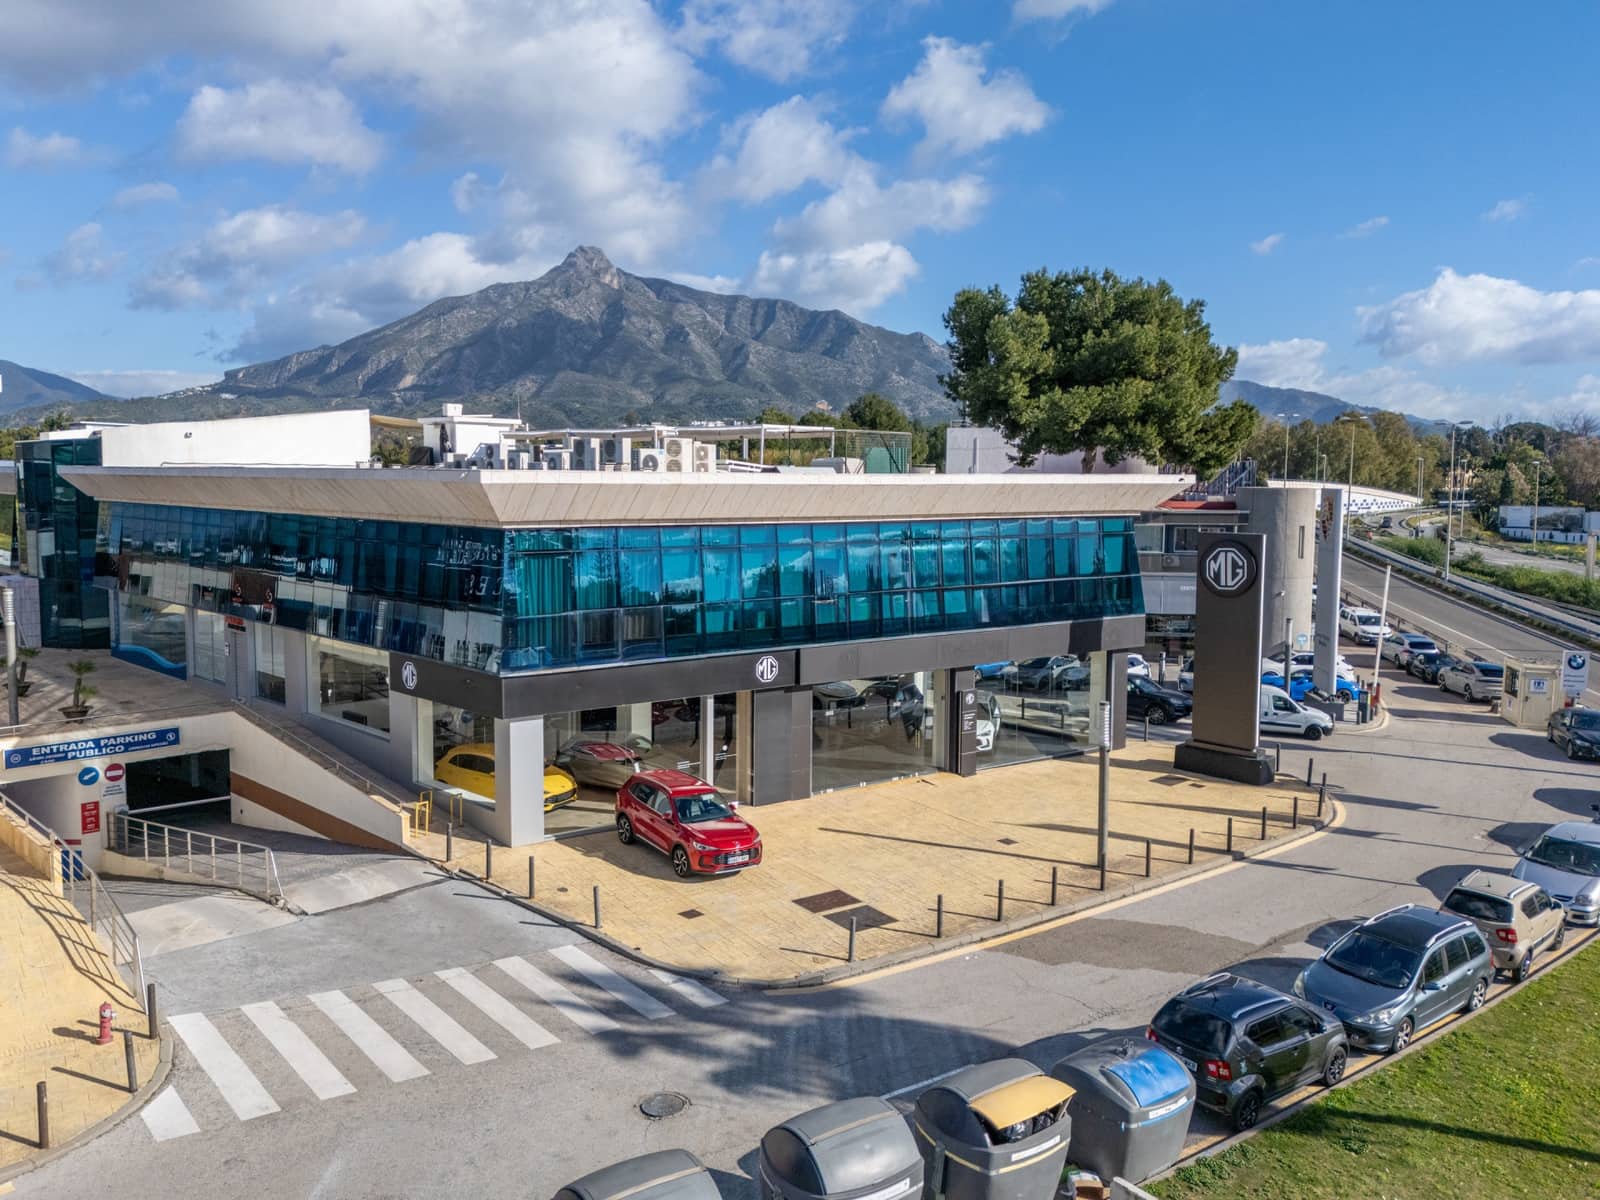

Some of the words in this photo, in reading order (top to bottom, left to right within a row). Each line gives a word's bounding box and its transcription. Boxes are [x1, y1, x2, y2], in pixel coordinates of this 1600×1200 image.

[1208, 549, 1245, 588] MG
[758, 657, 777, 681] MG
[31, 741, 96, 756] ENTRADA
[100, 732, 157, 747] PARKING
